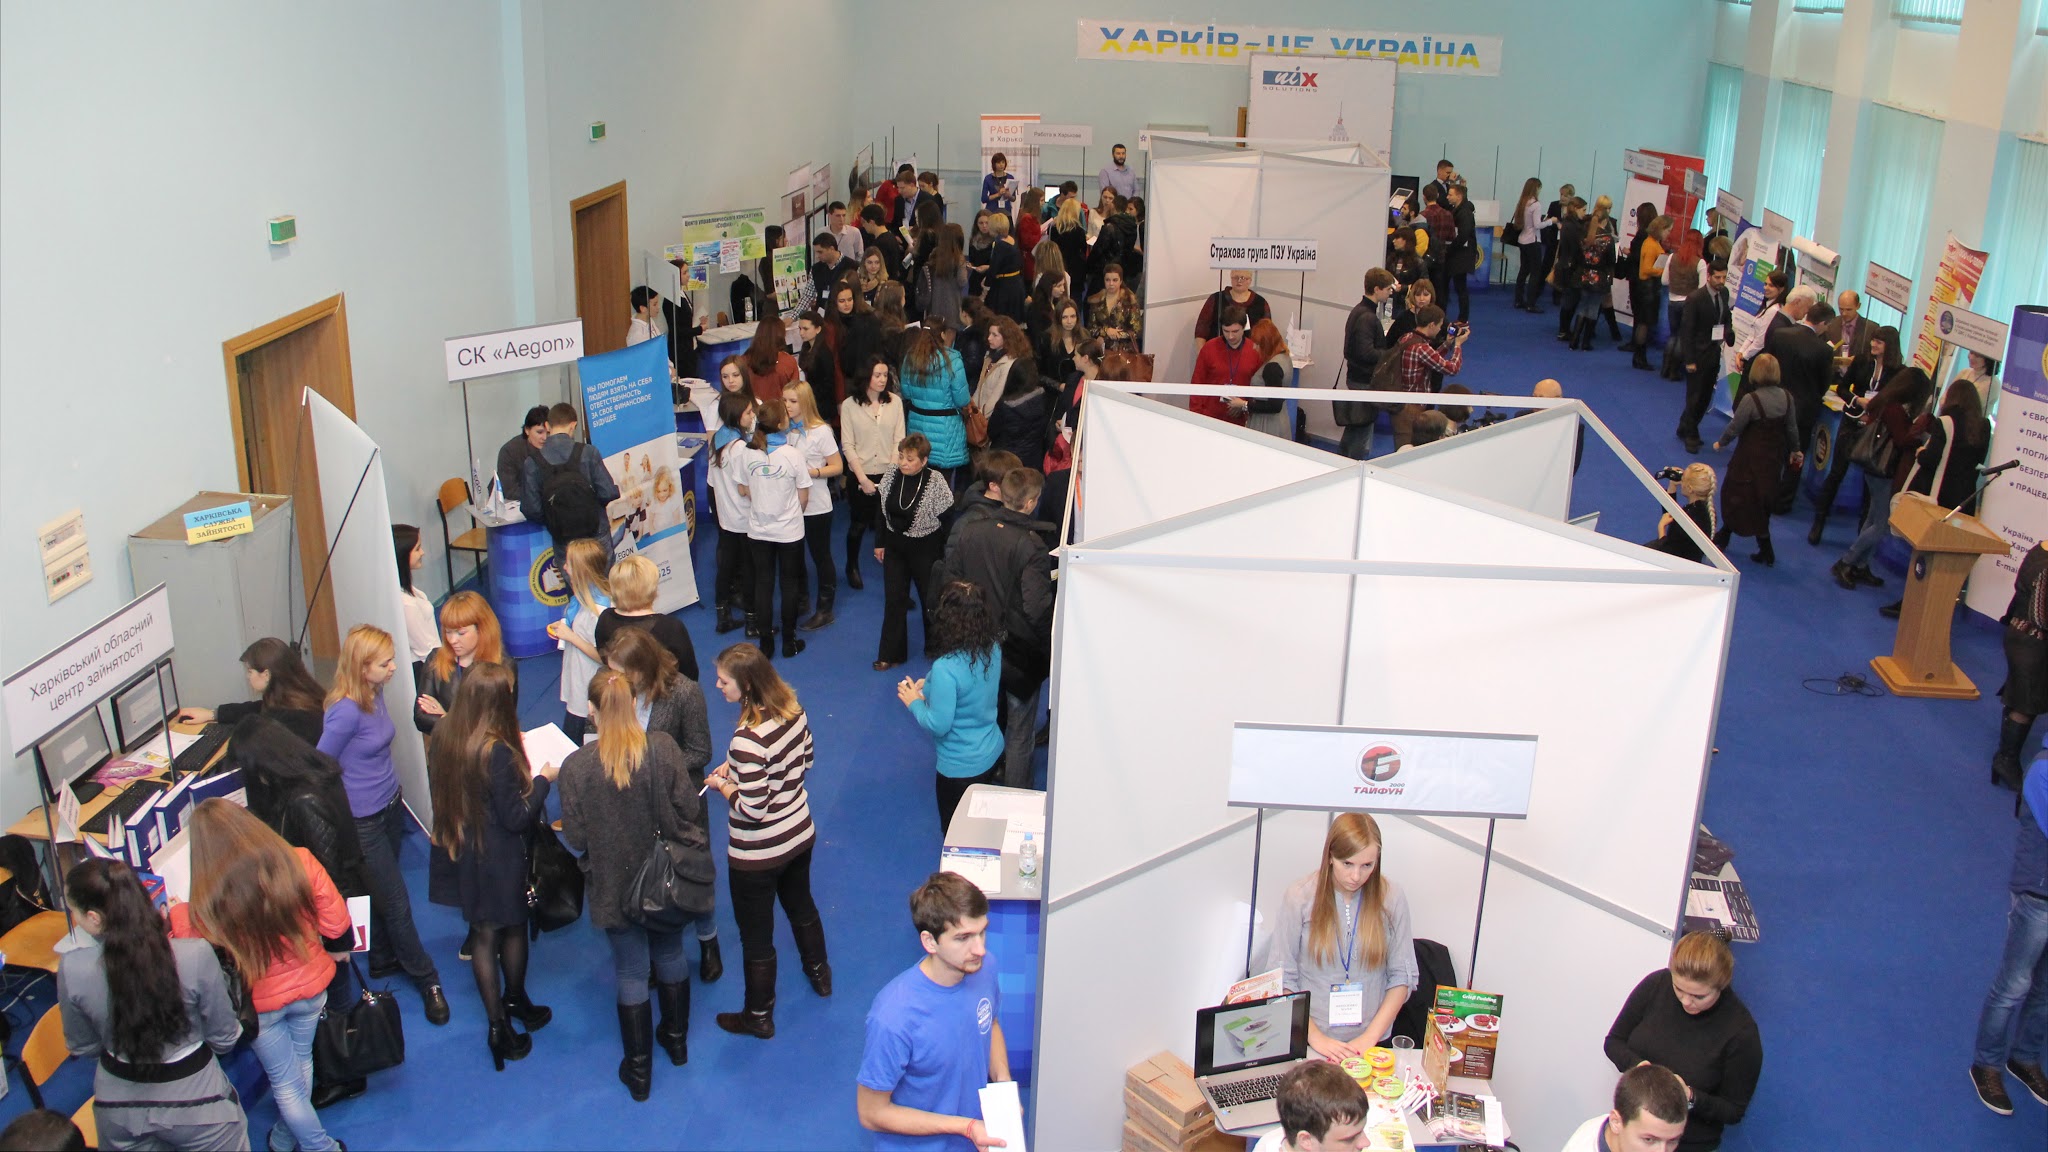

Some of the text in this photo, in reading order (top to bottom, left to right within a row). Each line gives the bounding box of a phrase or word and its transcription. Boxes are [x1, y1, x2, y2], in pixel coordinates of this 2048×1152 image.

[1331, 37, 1480, 69] УКРАЇНА
[1274, 66, 1318, 88] nix
[990, 126, 1024, 134] РАБОТ
[1210, 243, 1316, 263] Страхова група ПЗУ Україна
[457, 337, 575, 366] СК «Aegon»
[587, 375, 628, 393] МЫ ПОМОГАЕМ
[588, 376, 653, 402] ЛЮДЯМ ВЗЯТЬ НА СЕБЯ
[589, 388, 642, 411] ОТВЕТСТВЕННОСТЬ
[591, 393, 652, 420] ЗА СВОЕ ФИНАНСОВОЕ
[592, 413, 617, 428] БУДУЩЕЕ
[194, 507, 243, 522] ХАРКІВСЬКА
[204, 517, 236, 529] СЛУЖБА
[196, 523, 246, 538] ЗАЙНЯТОСТІ
[1995, 559, 2018, 574] E-mai
[29, 612, 154, 701] Харківський обласний
[50, 638, 144, 711] центр зайнятості
